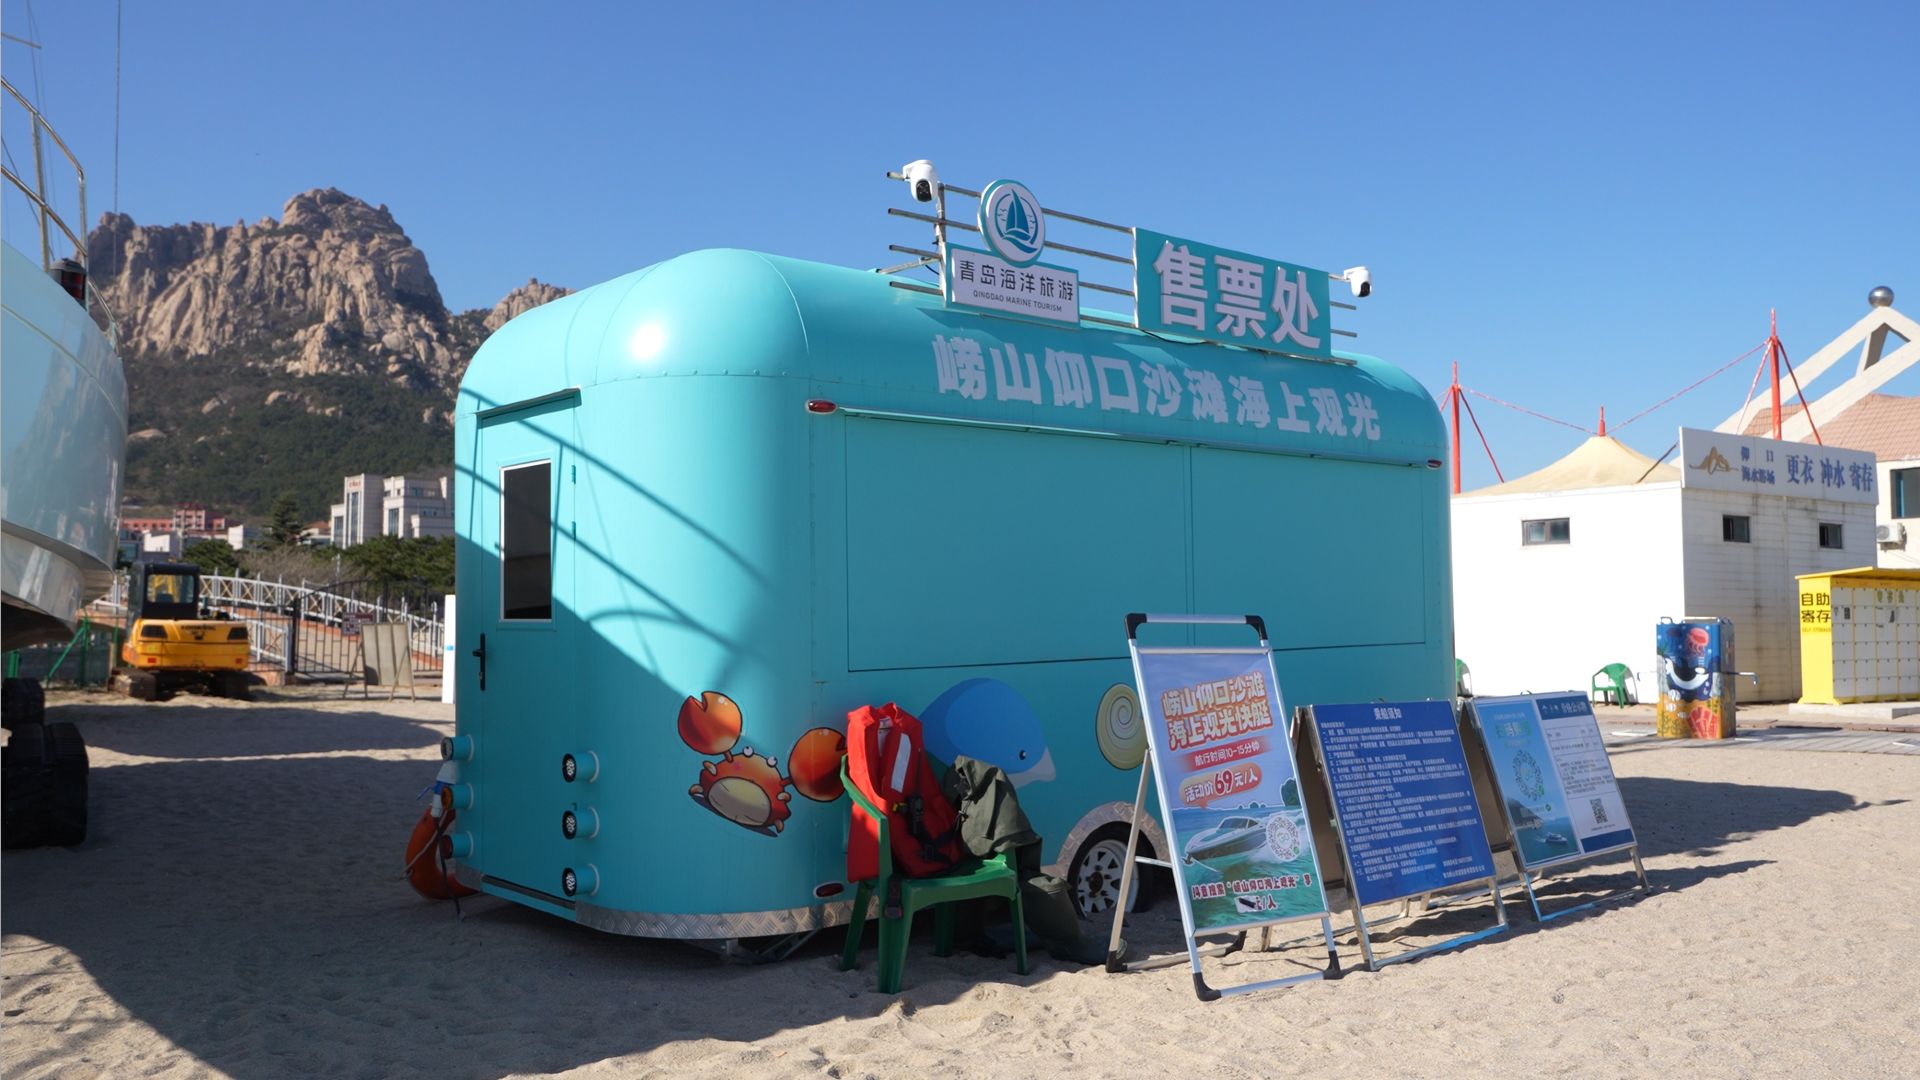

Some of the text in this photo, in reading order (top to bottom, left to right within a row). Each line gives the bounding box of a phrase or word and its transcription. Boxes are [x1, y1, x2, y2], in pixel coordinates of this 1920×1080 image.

[958, 258, 1075, 302] 青岛海洋旅游
[1153, 240, 1321, 349] 售票处
[972, 289, 1063, 314] QINGDAO MARINE TOURISM
[932, 333, 1382, 441] 崂山仰口沙滩海上观光
[1741, 465, 1776, 485] 海水浴场
[1786, 454, 1874, 492] 更衣 冲水 寄存
[1801, 592, 1831, 606] 自助
[1801, 609, 1832, 623] 寄存
[1162, 671, 1266, 718] 崂山仰口沙滩
[1169, 699, 1273, 749] 海上观光快艇
[1373, 707, 1403, 720] 乘船须知
[1495, 720, 1532, 739] 扫码购票
[1194, 741, 1261, 767] 航行时间10-15分钟
[1185, 767, 1259, 803] 活动价69元/人
